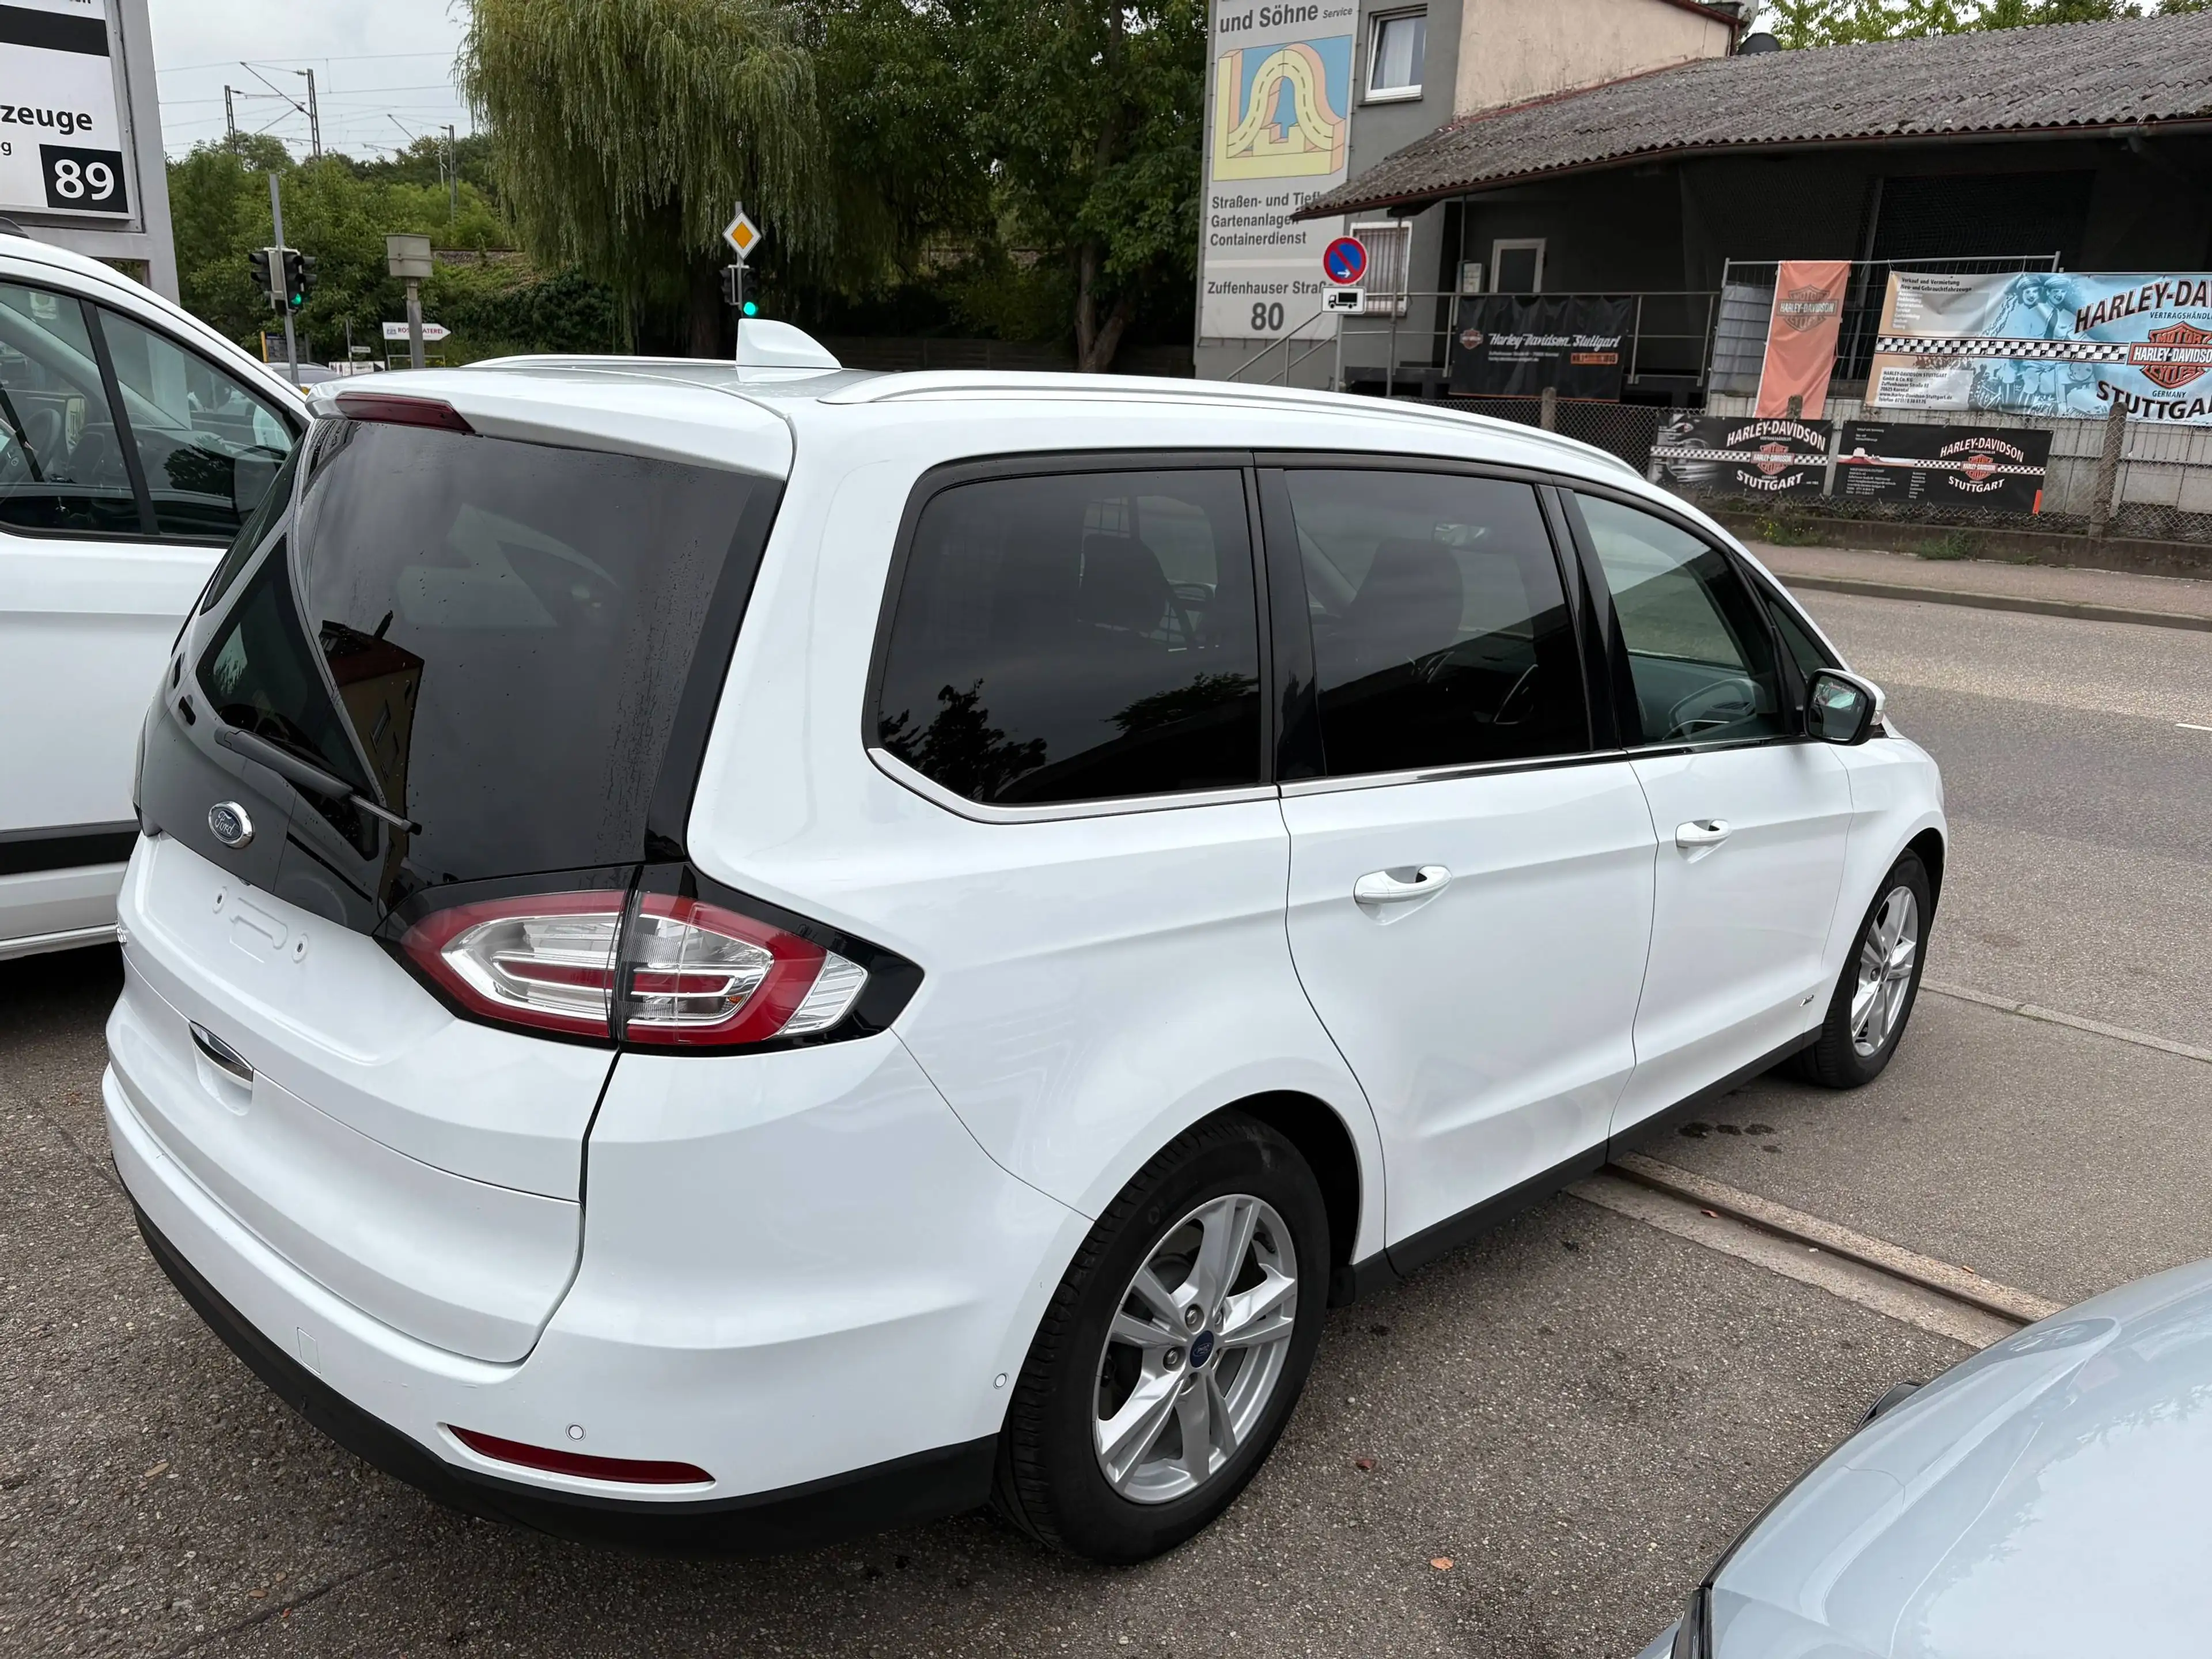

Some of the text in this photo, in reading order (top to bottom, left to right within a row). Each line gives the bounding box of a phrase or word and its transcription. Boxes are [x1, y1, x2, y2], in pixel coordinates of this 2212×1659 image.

[1220, 4, 1353, 33] und Söhne Service
[0, 105, 92, 135] zeuge
[54, 159, 114, 200] 89
[1212, 195, 1262, 209] Straßen-
[1266, 193, 1289, 206] und
[1210, 231, 1306, 246] Containerdienst
[1208, 281, 1289, 294] Zuffenhauser
[1251, 302, 1284, 331] 80
[1780, 302, 1834, 313] HARLEY-DAVIDSON
[2074, 280, 2212, 334] HARLEY-DA
[1488, 333, 1622, 352] Harley-Davidson Stuttgart
[2156, 329, 2201, 344] MOTOR
[2096, 380, 2212, 419] STUTTGA
[1726, 420, 1826, 452] HARLEY-DAVIDSON
[1940, 437, 2024, 463] HARLEY-DAVIDSON
[1736, 469, 1804, 491] STUTTGART
[1948, 475, 2005, 493] STUTTGART
[215, 811, 236, 835] Ford
